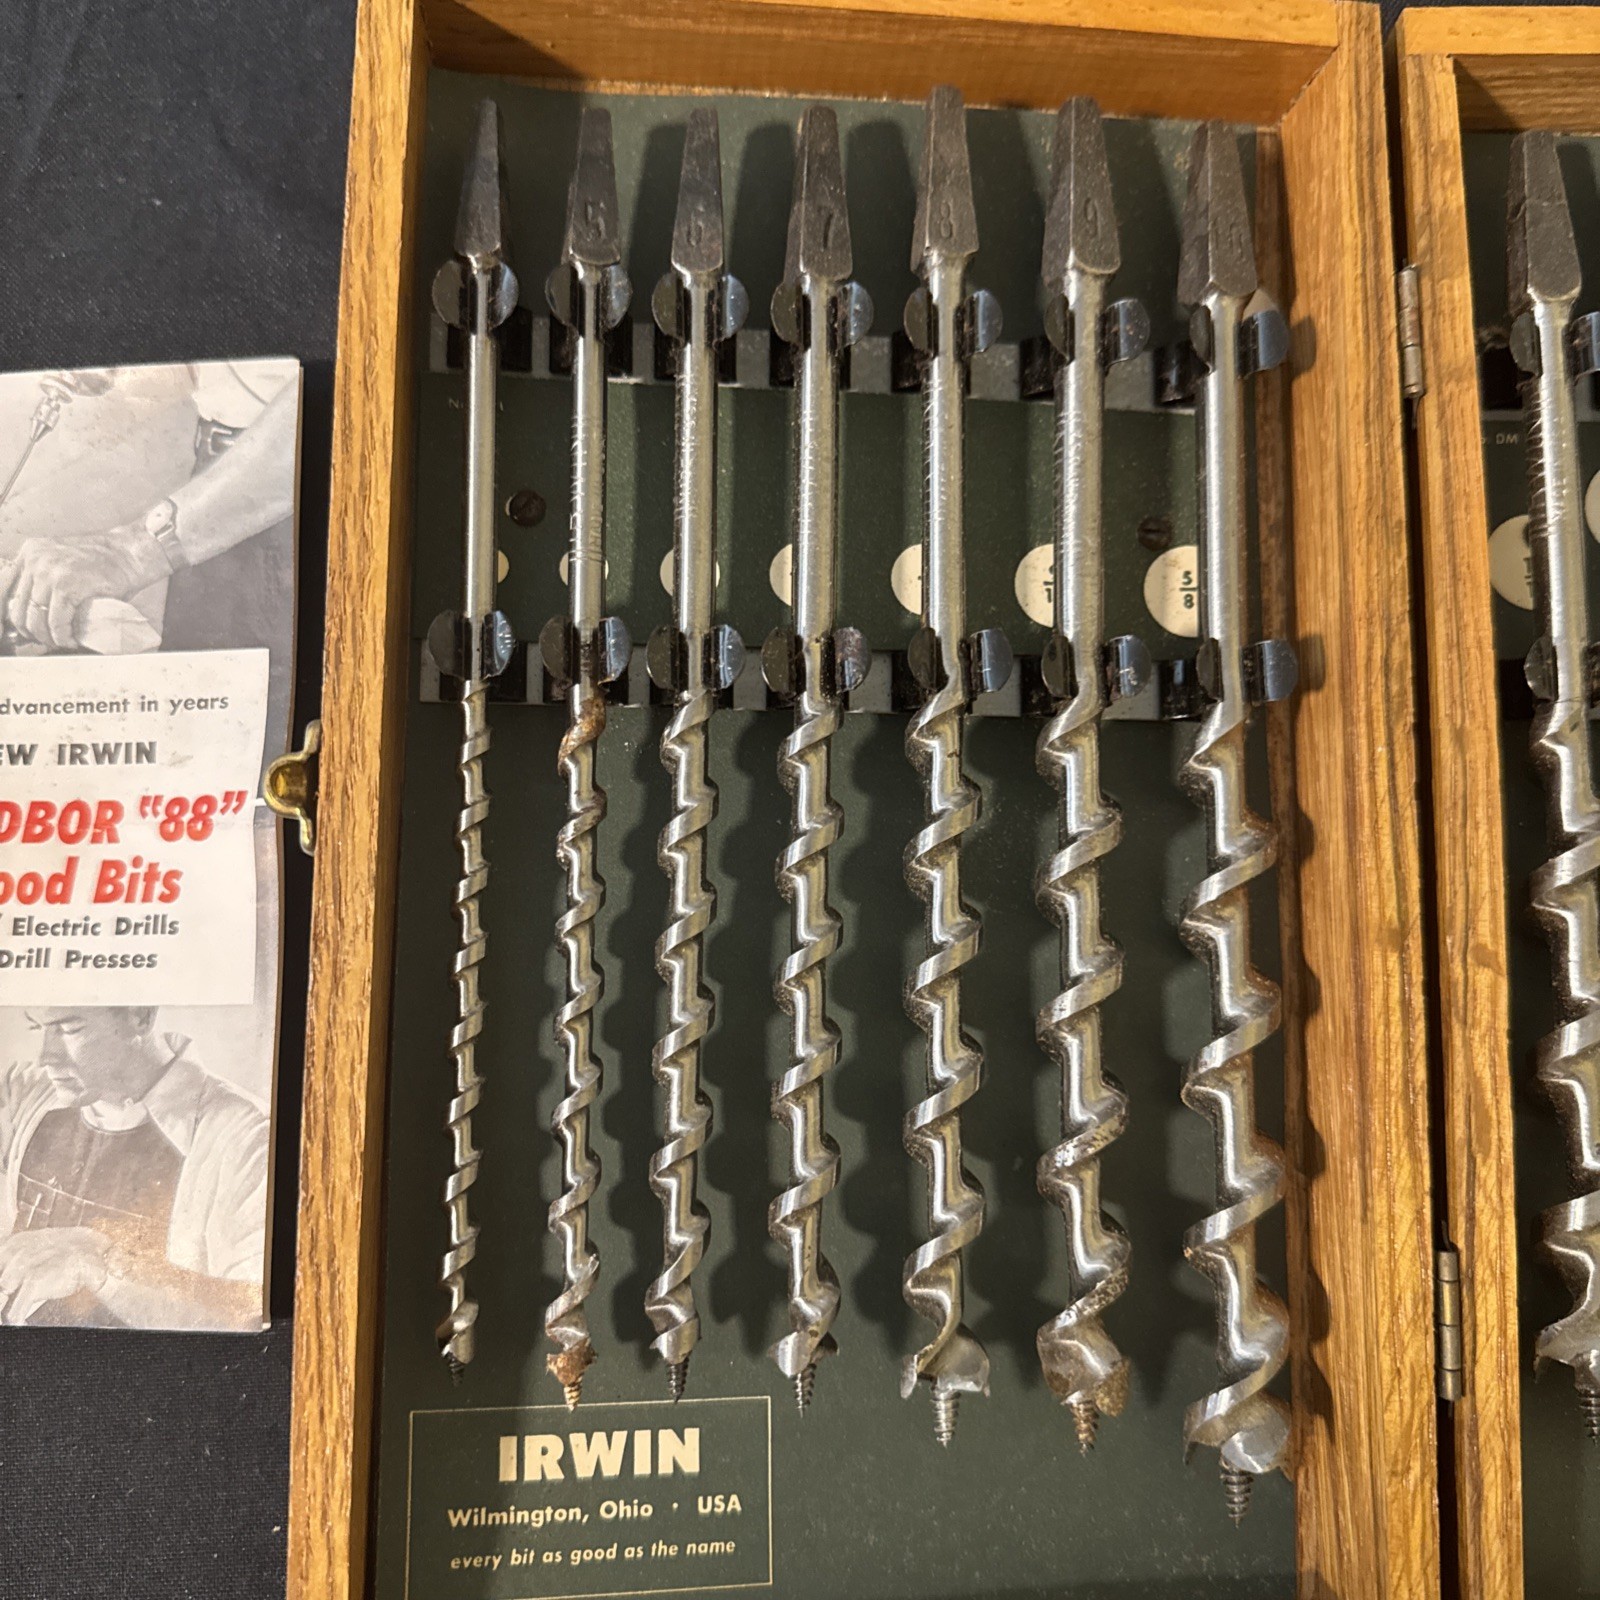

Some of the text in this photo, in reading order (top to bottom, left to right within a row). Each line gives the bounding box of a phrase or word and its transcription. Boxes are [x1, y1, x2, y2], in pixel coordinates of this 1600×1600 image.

[939, 199, 957, 239] 8
[1083, 196, 1101, 240] 9
[140, 695, 159, 713] in
[169, 696, 230, 716] years
[57, 741, 158, 766] IRWIN
[93, 854, 184, 904] Bits
[12, 914, 180, 937] Electric Drills
[0, 947, 159, 969] Drill Presses
[498, 1427, 701, 1483] IRWIN
[447, 1493, 742, 1528] Wilmington, Ohio USA
[450, 1539, 736, 1571] every bit as good as the name
